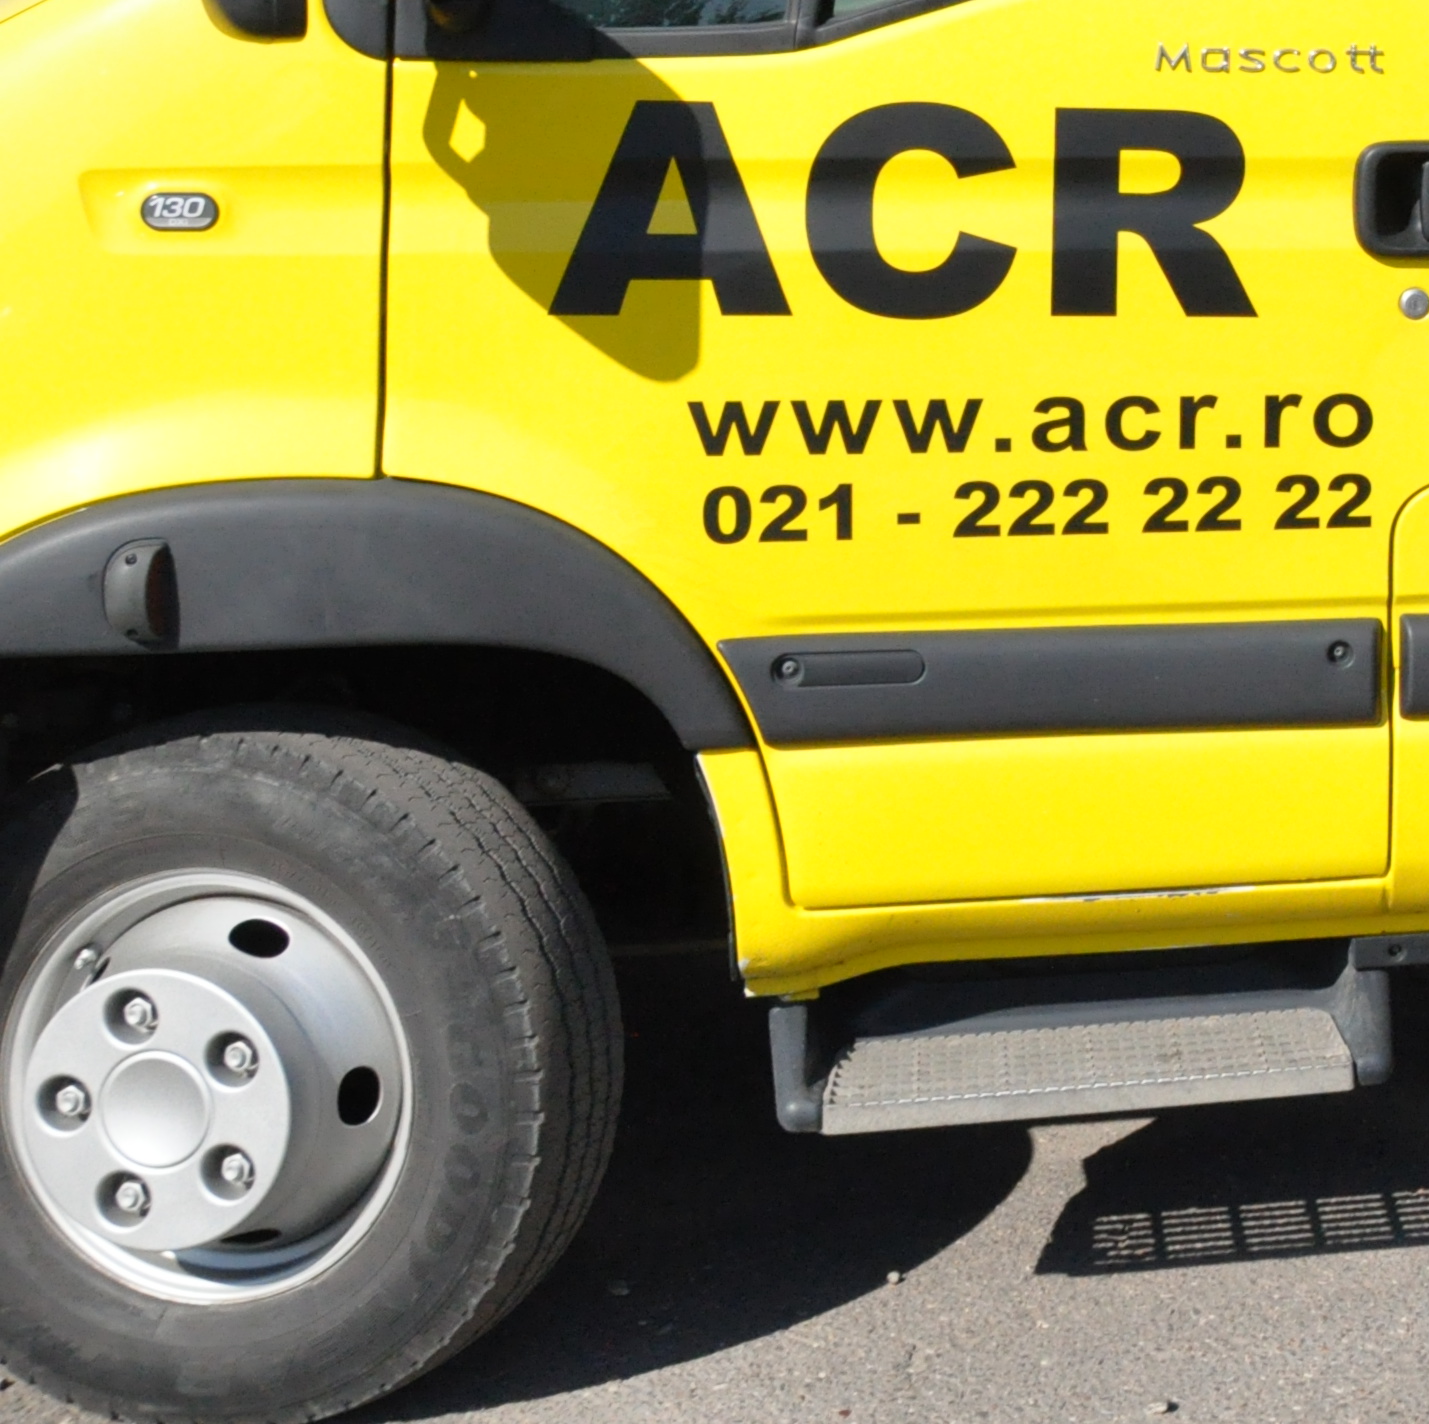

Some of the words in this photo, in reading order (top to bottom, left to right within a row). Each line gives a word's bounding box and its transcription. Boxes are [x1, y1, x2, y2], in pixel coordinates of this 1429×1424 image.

[1154, 40, 1387, 74] Mascott
[148, 196, 206, 218] 130
[548, 99, 1257, 319] ACR
[687, 392, 1374, 457] www.acr.ro
[703, 484, 853, 544] 021
[896, 513, 921, 525] -
[953, 479, 1109, 538] 222
[1142, 476, 1242, 533] 22
[1274, 474, 1373, 529] 22
